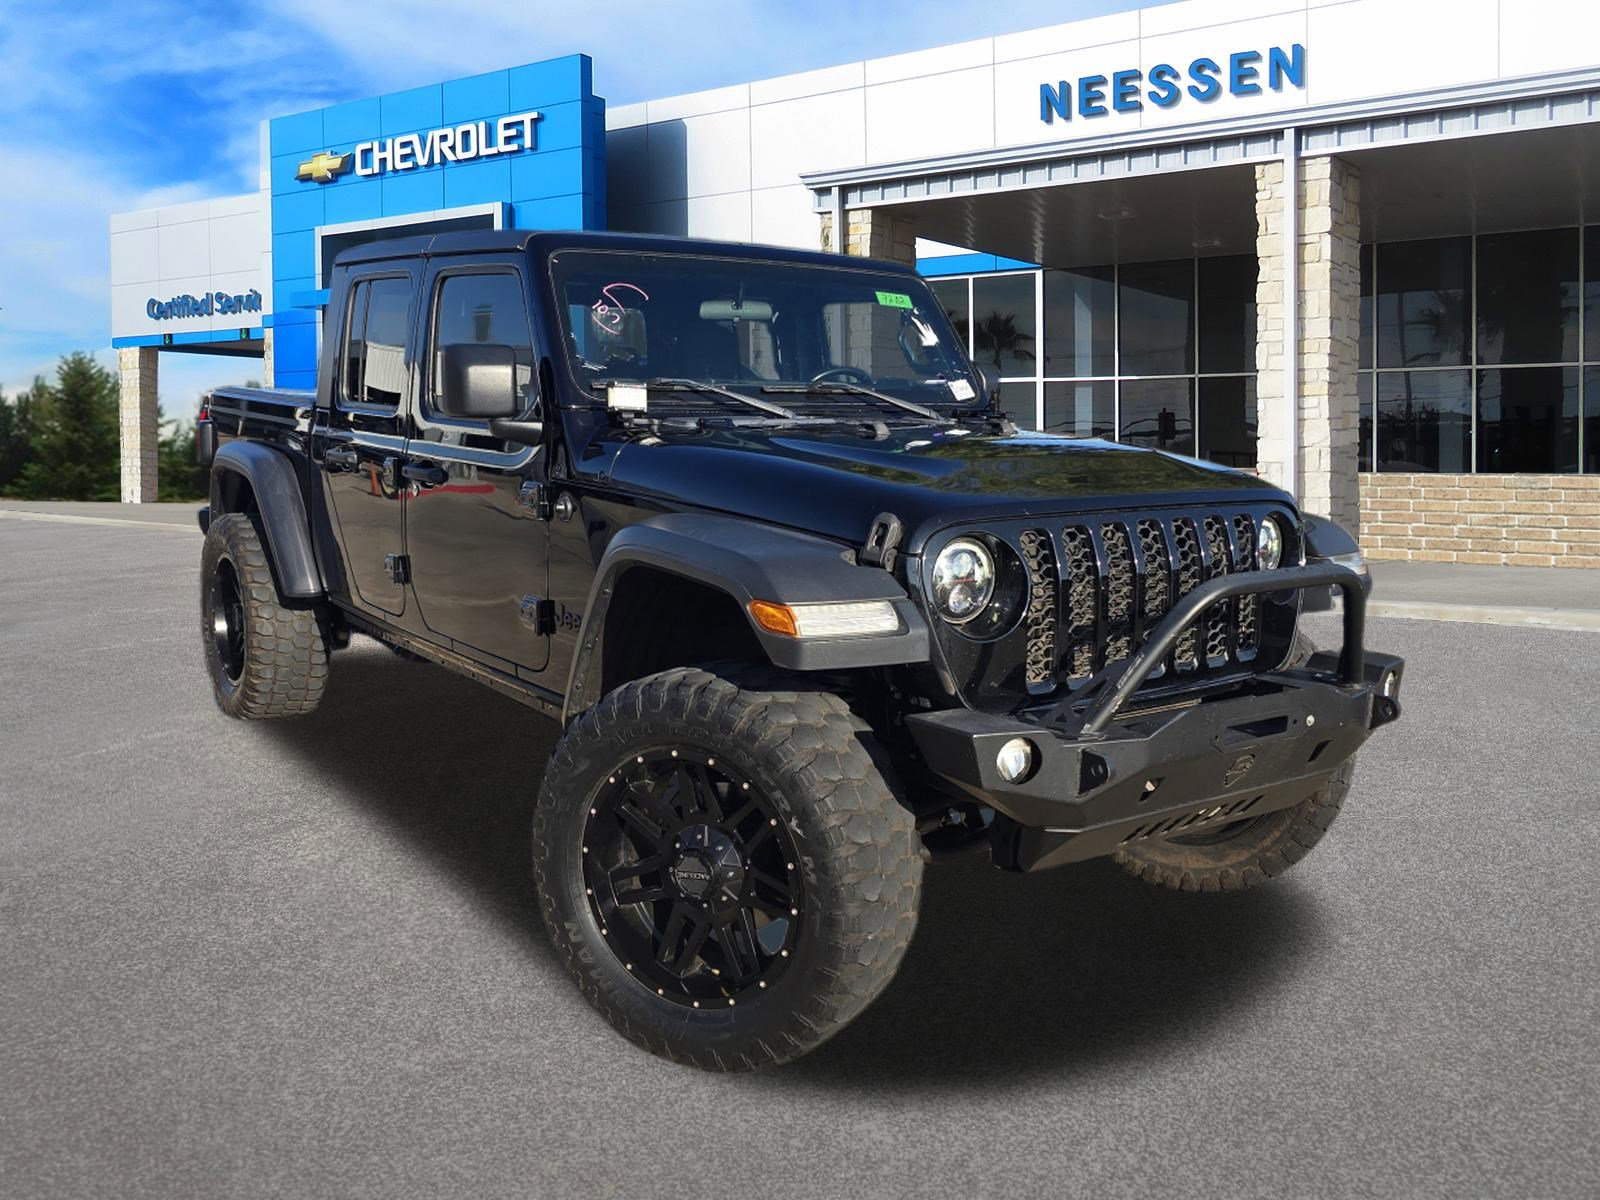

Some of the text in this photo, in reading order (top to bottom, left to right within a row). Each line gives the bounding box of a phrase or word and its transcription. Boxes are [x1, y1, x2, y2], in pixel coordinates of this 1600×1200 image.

[1040, 43, 1305, 124] NEESSEN
[354, 111, 543, 177] CHEVROLET
[147, 292, 213, 320] Certified
[555, 603, 582, 631] Jee
